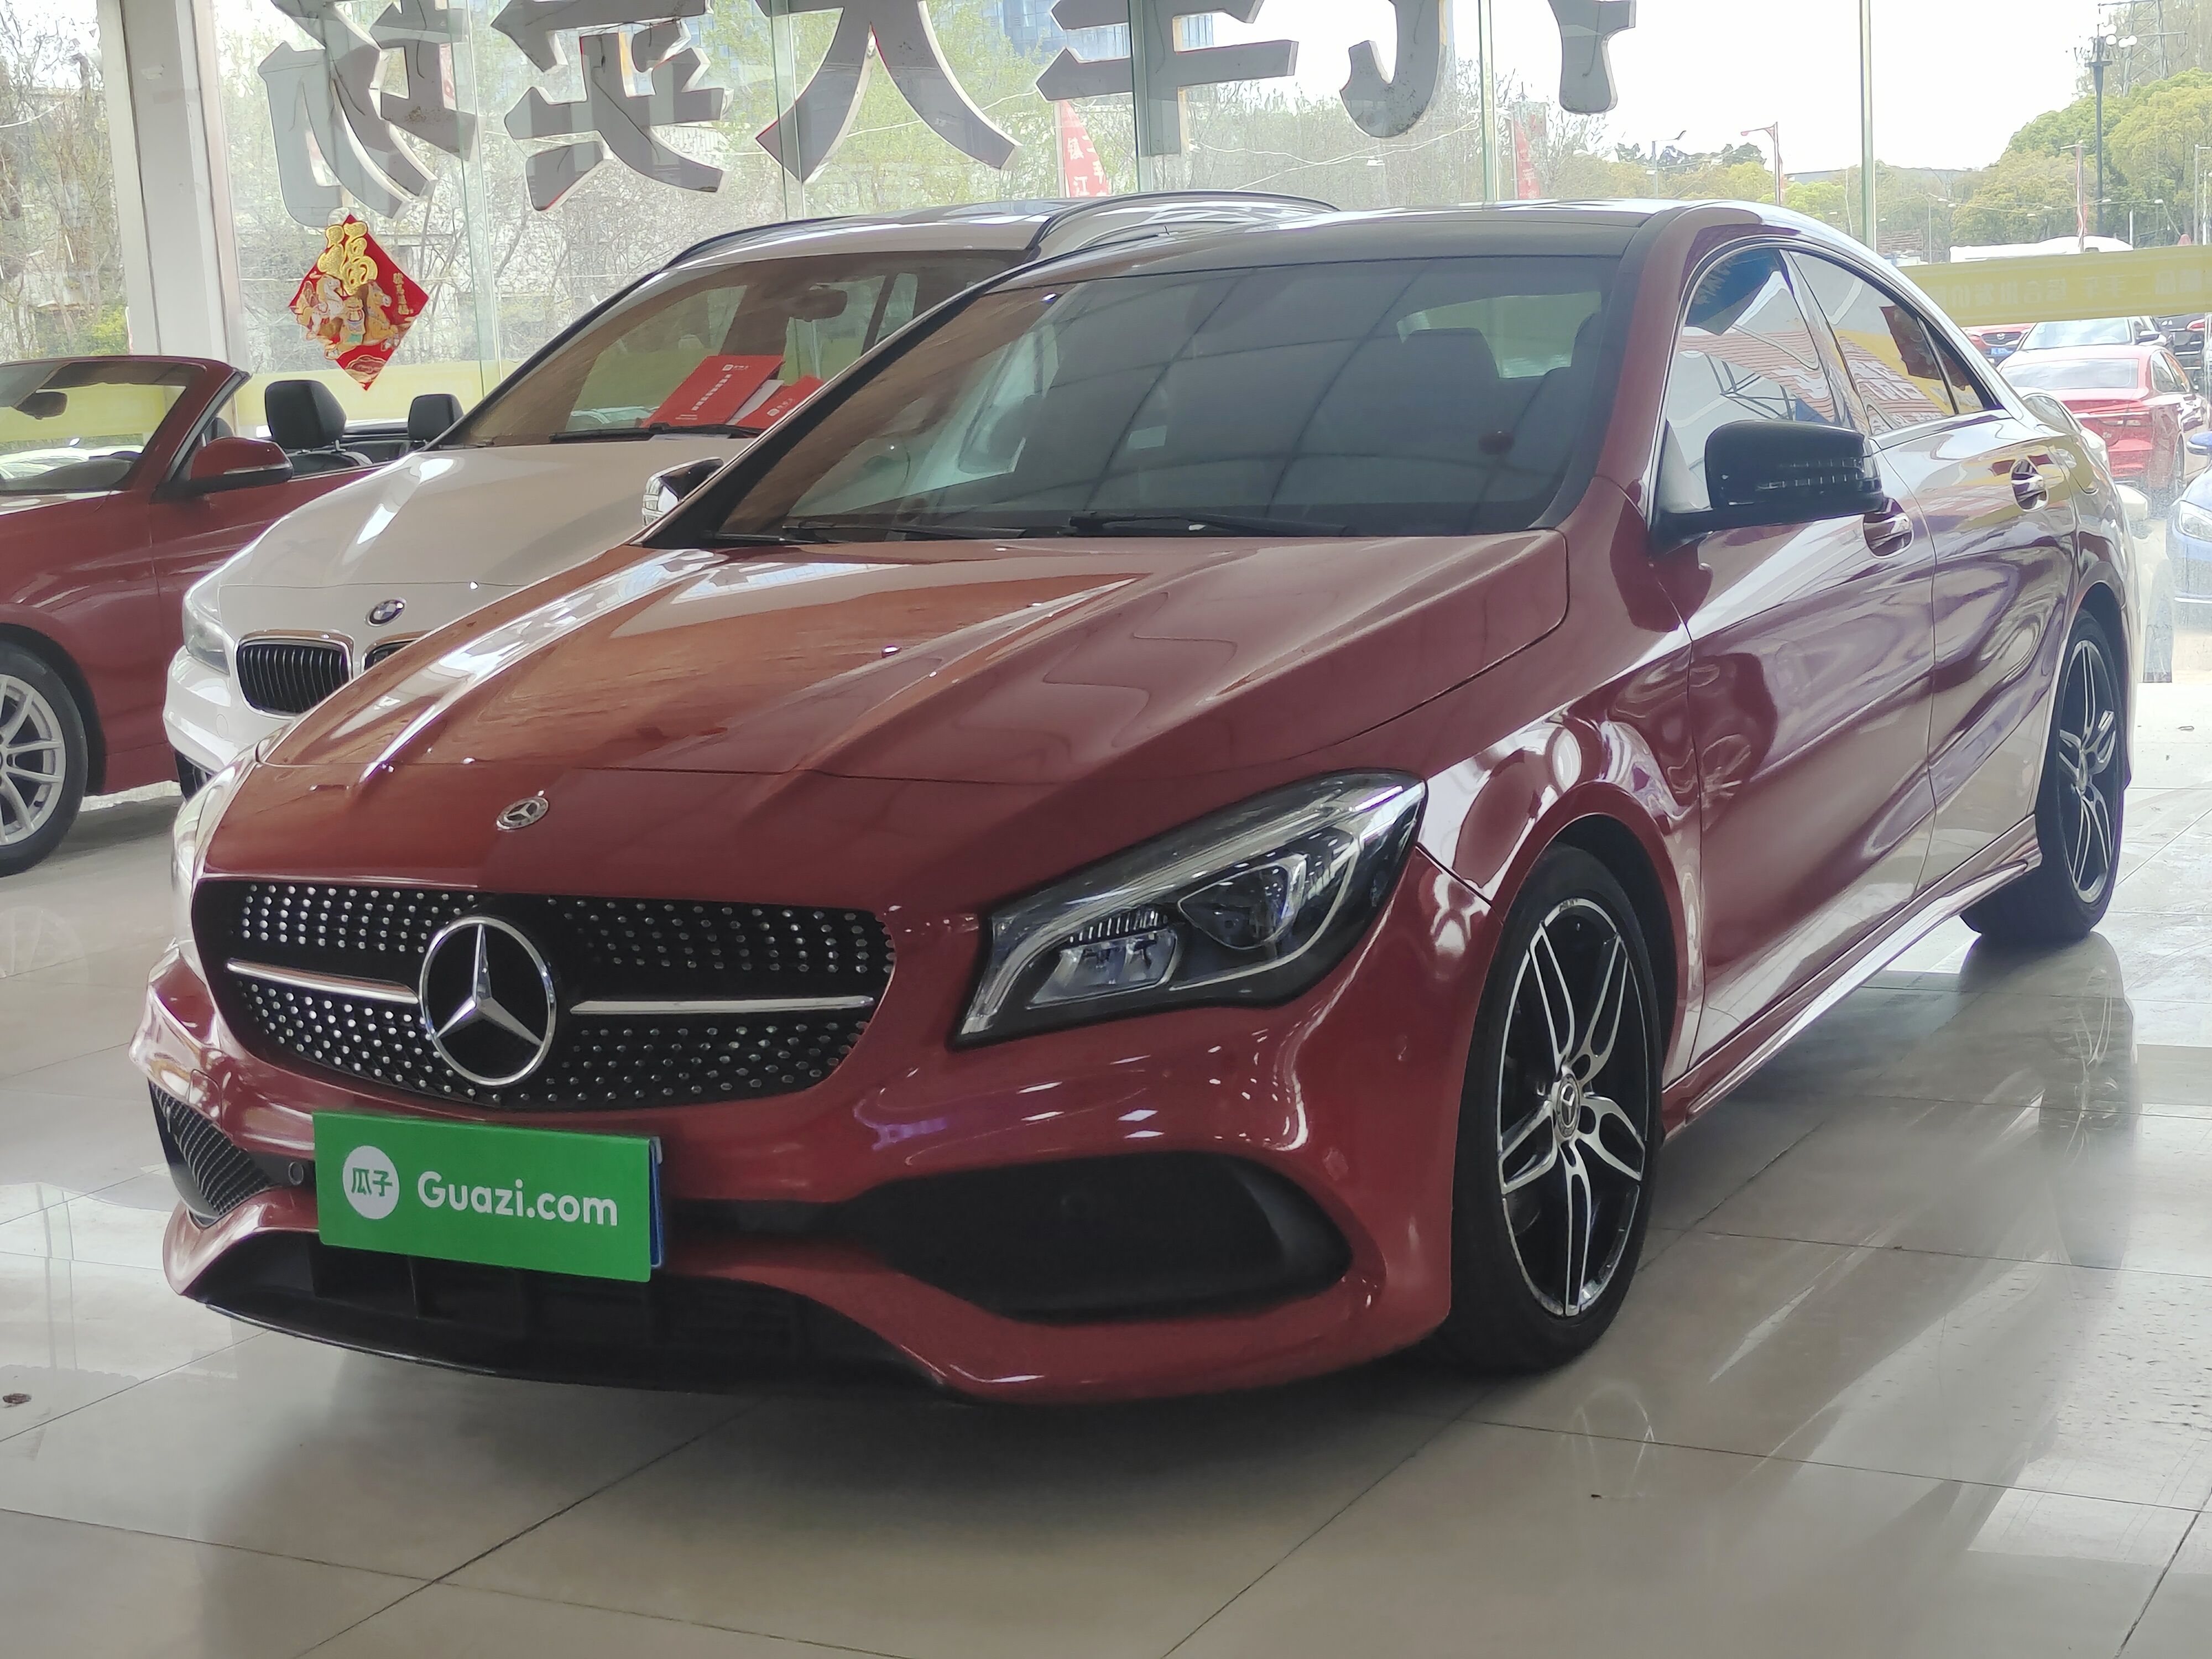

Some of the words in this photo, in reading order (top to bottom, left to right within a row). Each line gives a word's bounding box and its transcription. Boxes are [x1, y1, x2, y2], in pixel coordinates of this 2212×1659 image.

[317, 221, 378, 295] 福
[351, 1167, 393, 1197] 瓜子
[418, 1170, 618, 1226] Guazi.com
